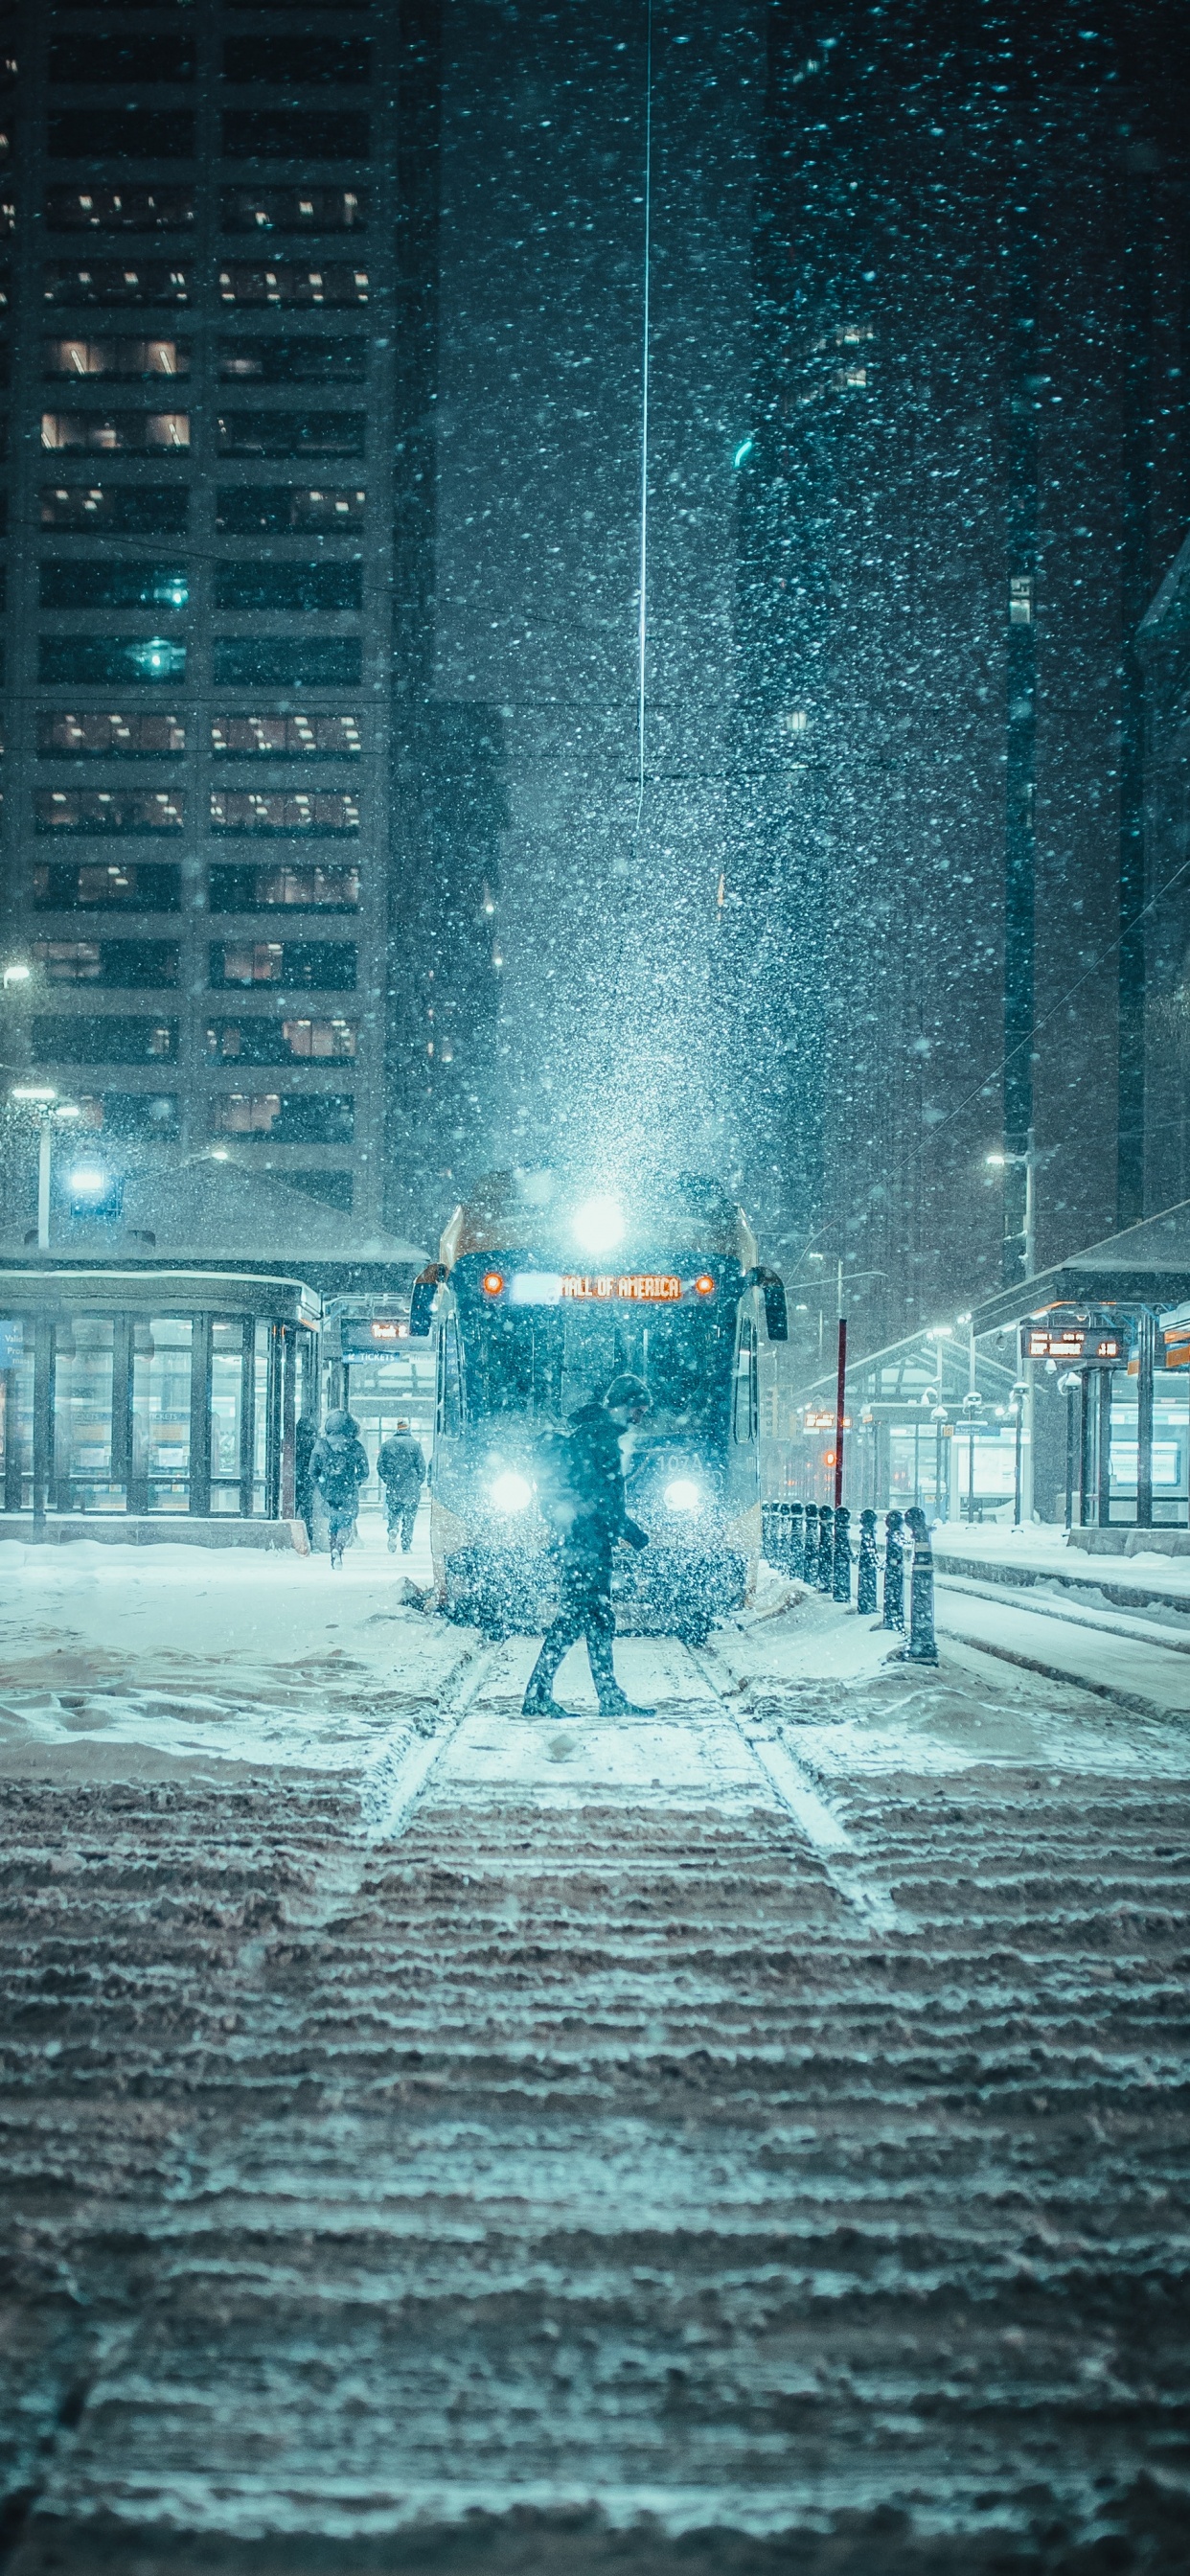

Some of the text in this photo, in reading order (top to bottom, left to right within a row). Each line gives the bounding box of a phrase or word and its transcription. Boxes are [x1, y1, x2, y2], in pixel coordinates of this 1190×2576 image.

[597, 1276, 614, 1297] OF
[618, 1276, 679, 1298] AMERICA
[360, 1352, 395, 1361] TICKETS
